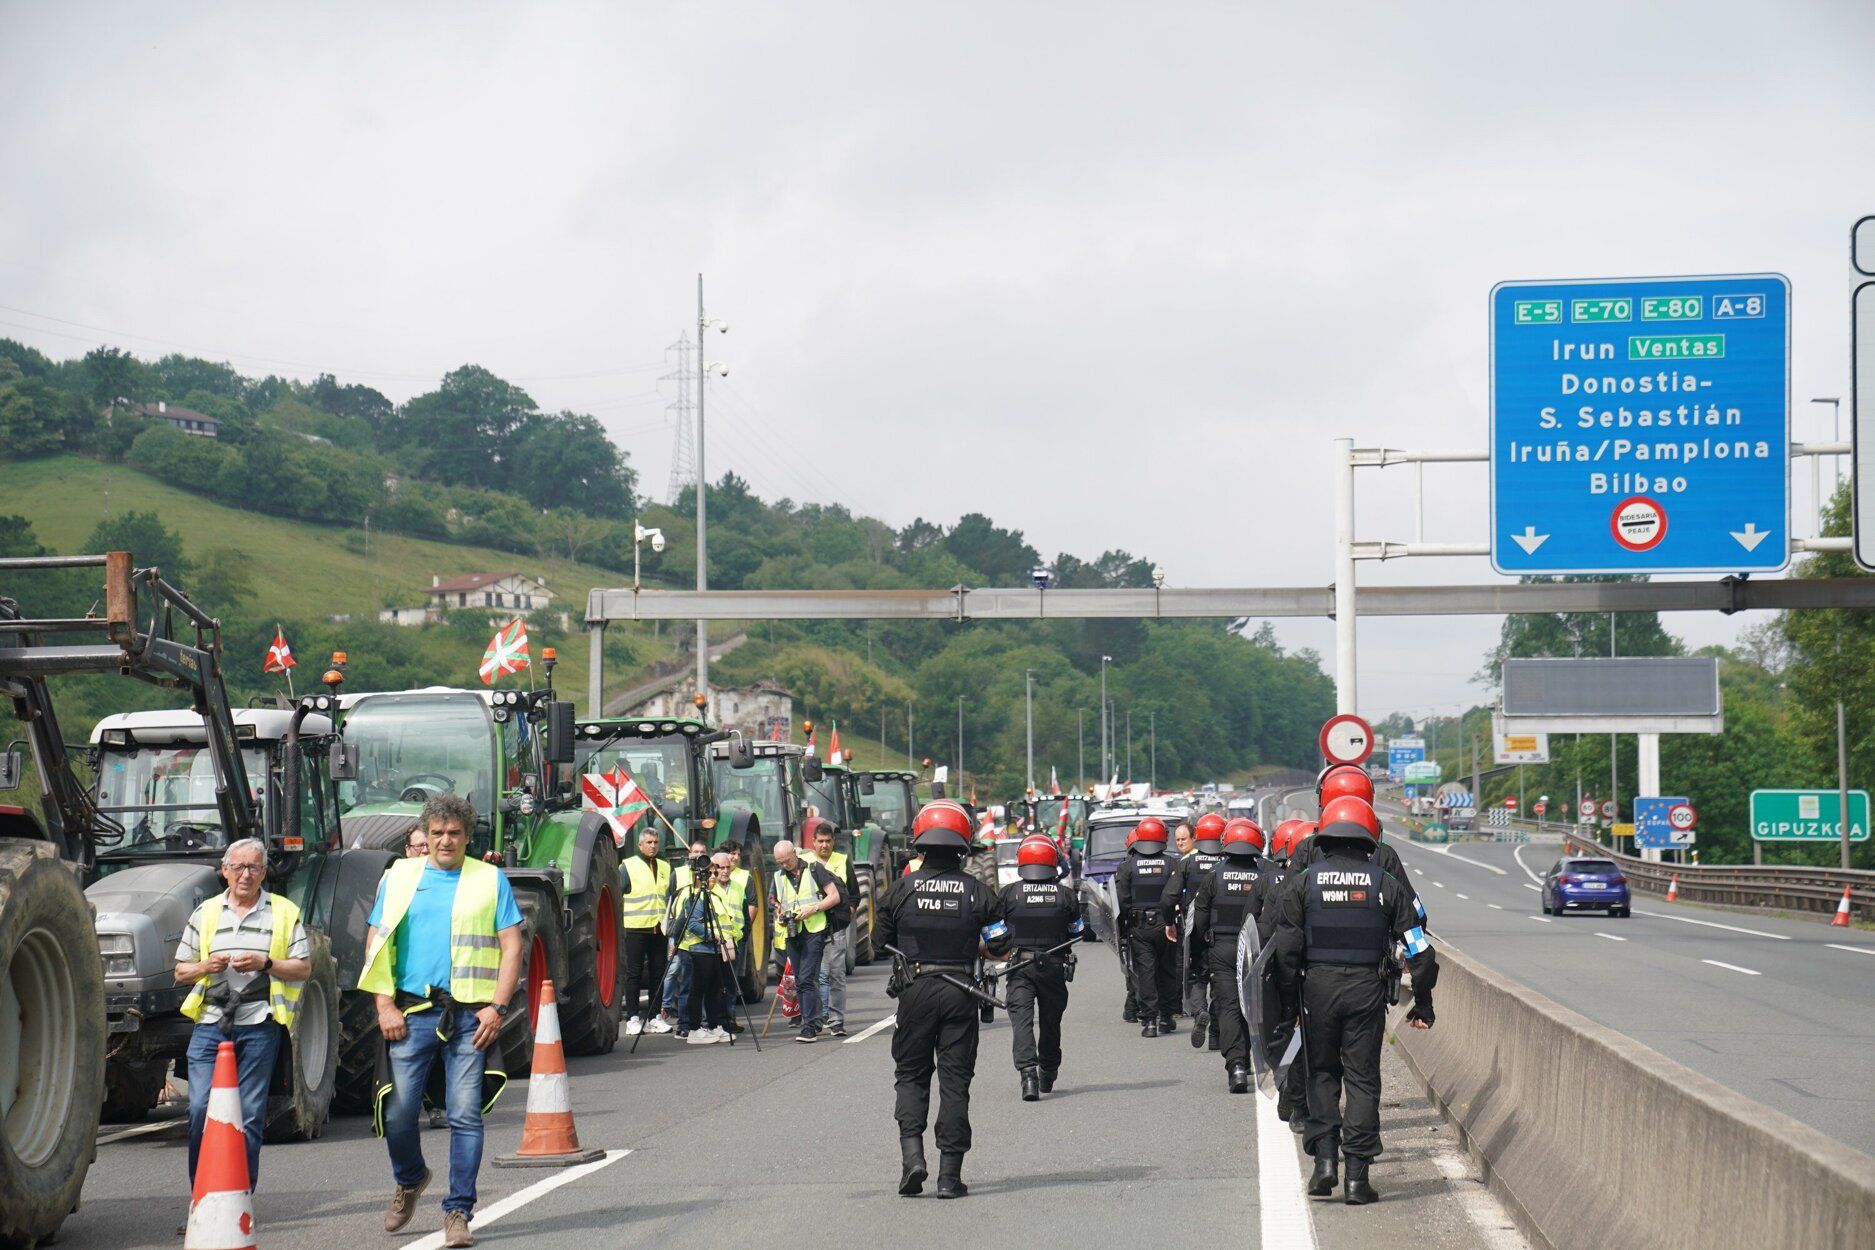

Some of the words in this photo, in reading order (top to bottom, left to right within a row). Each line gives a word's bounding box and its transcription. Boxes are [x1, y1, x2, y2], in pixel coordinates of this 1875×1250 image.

[1518, 303, 1559, 321] E-5
[1574, 301, 1629, 320] E-70
[1643, 299, 1700, 318] E-80
[1716, 297, 1761, 316] A-8
[1552, 339, 1615, 361] Irun
[1635, 338, 1719, 358] Ventas
[1561, 371, 1713, 395] Donostia-
[1538, 406, 1563, 429] S.
[1577, 403, 1741, 429] Sebastián
[1510, 438, 1769, 464] Iruña/Pamplona
[1590, 472, 1688, 495] Bilbao
[1672, 813, 1693, 822] 100
[1222, 871, 1259, 881] ERTZAINTZA
[1316, 871, 1372, 887] ERTZAINTZA
[914, 879, 965, 894] ERTZAINTZA
[1022, 883, 1059, 893] ERTZAINTZA
[917, 898, 941, 910] V7L6
[1322, 890, 1348, 902] W9M1
